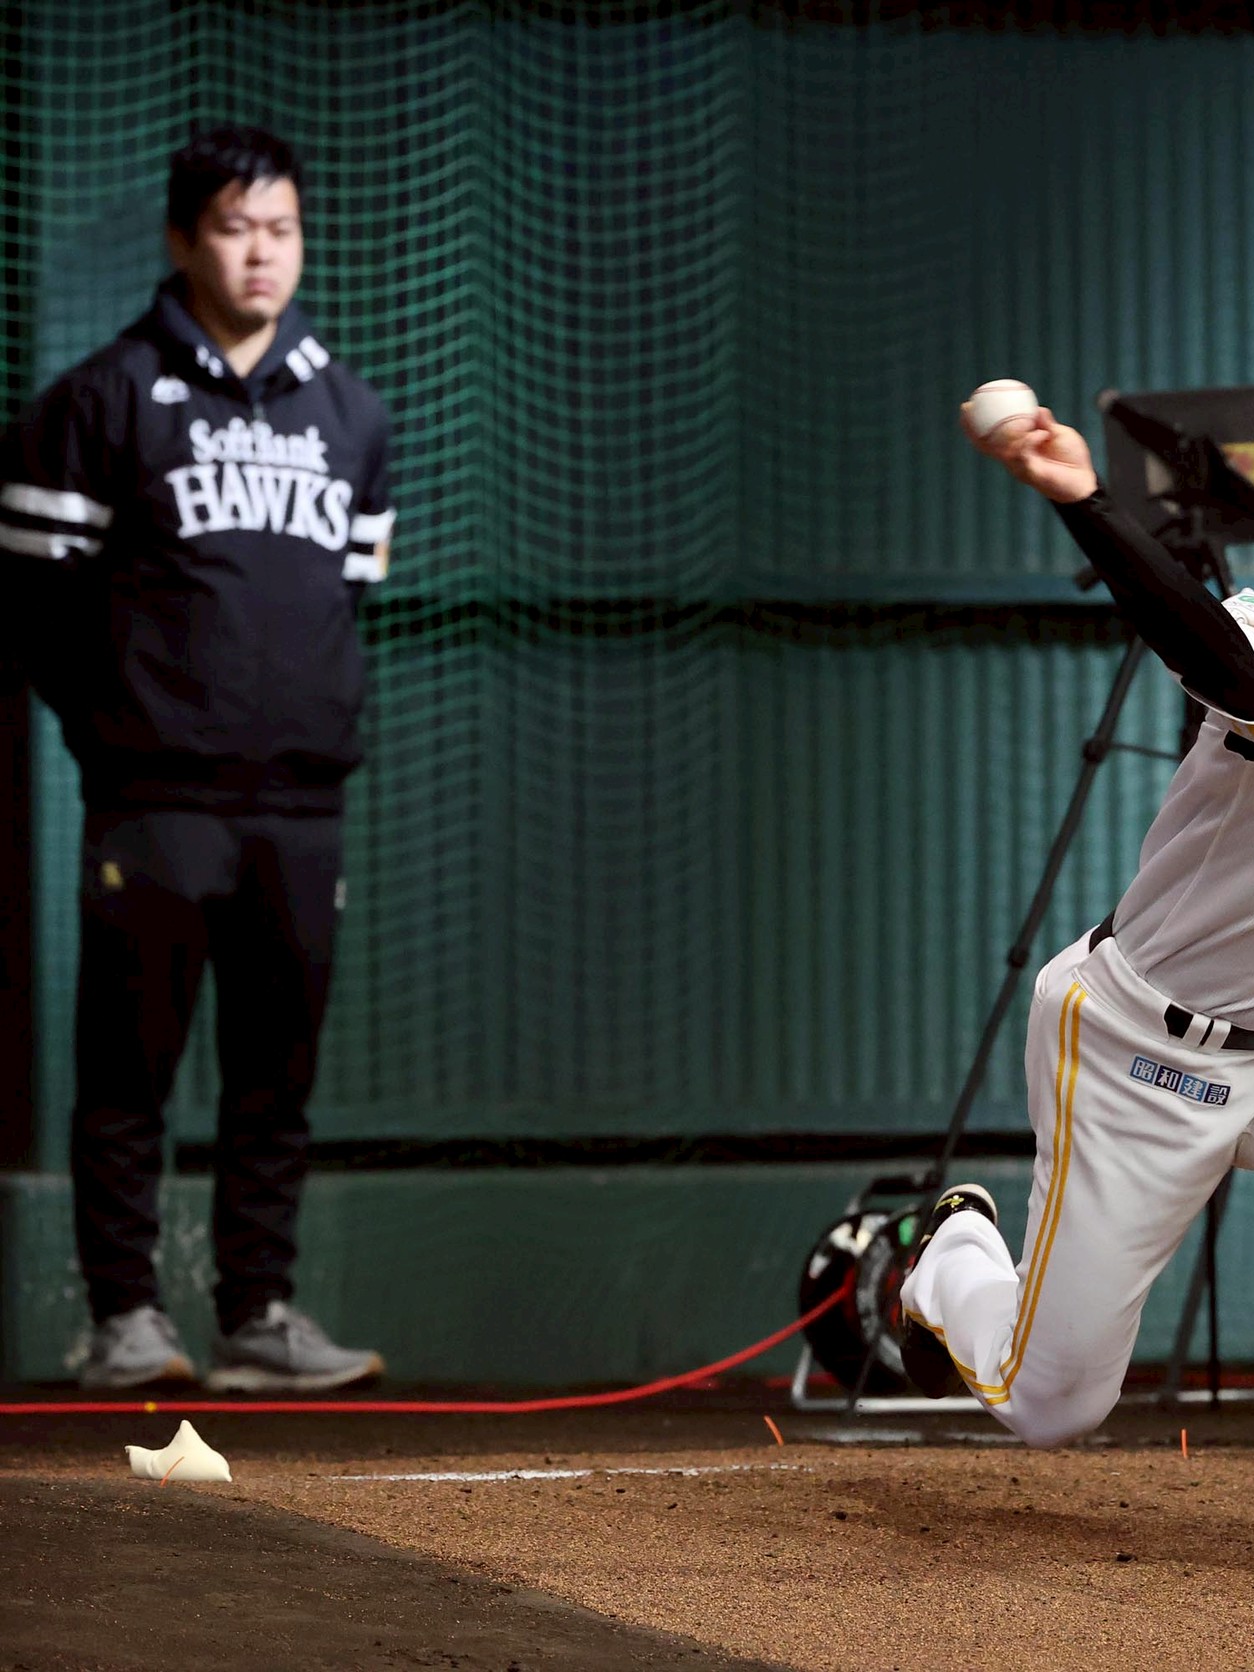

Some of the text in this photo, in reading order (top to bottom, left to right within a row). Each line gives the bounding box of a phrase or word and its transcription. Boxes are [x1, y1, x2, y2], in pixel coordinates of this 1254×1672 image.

[164, 461, 354, 551] HAWKS
[1131, 1057, 1230, 1105] 昭和建設
